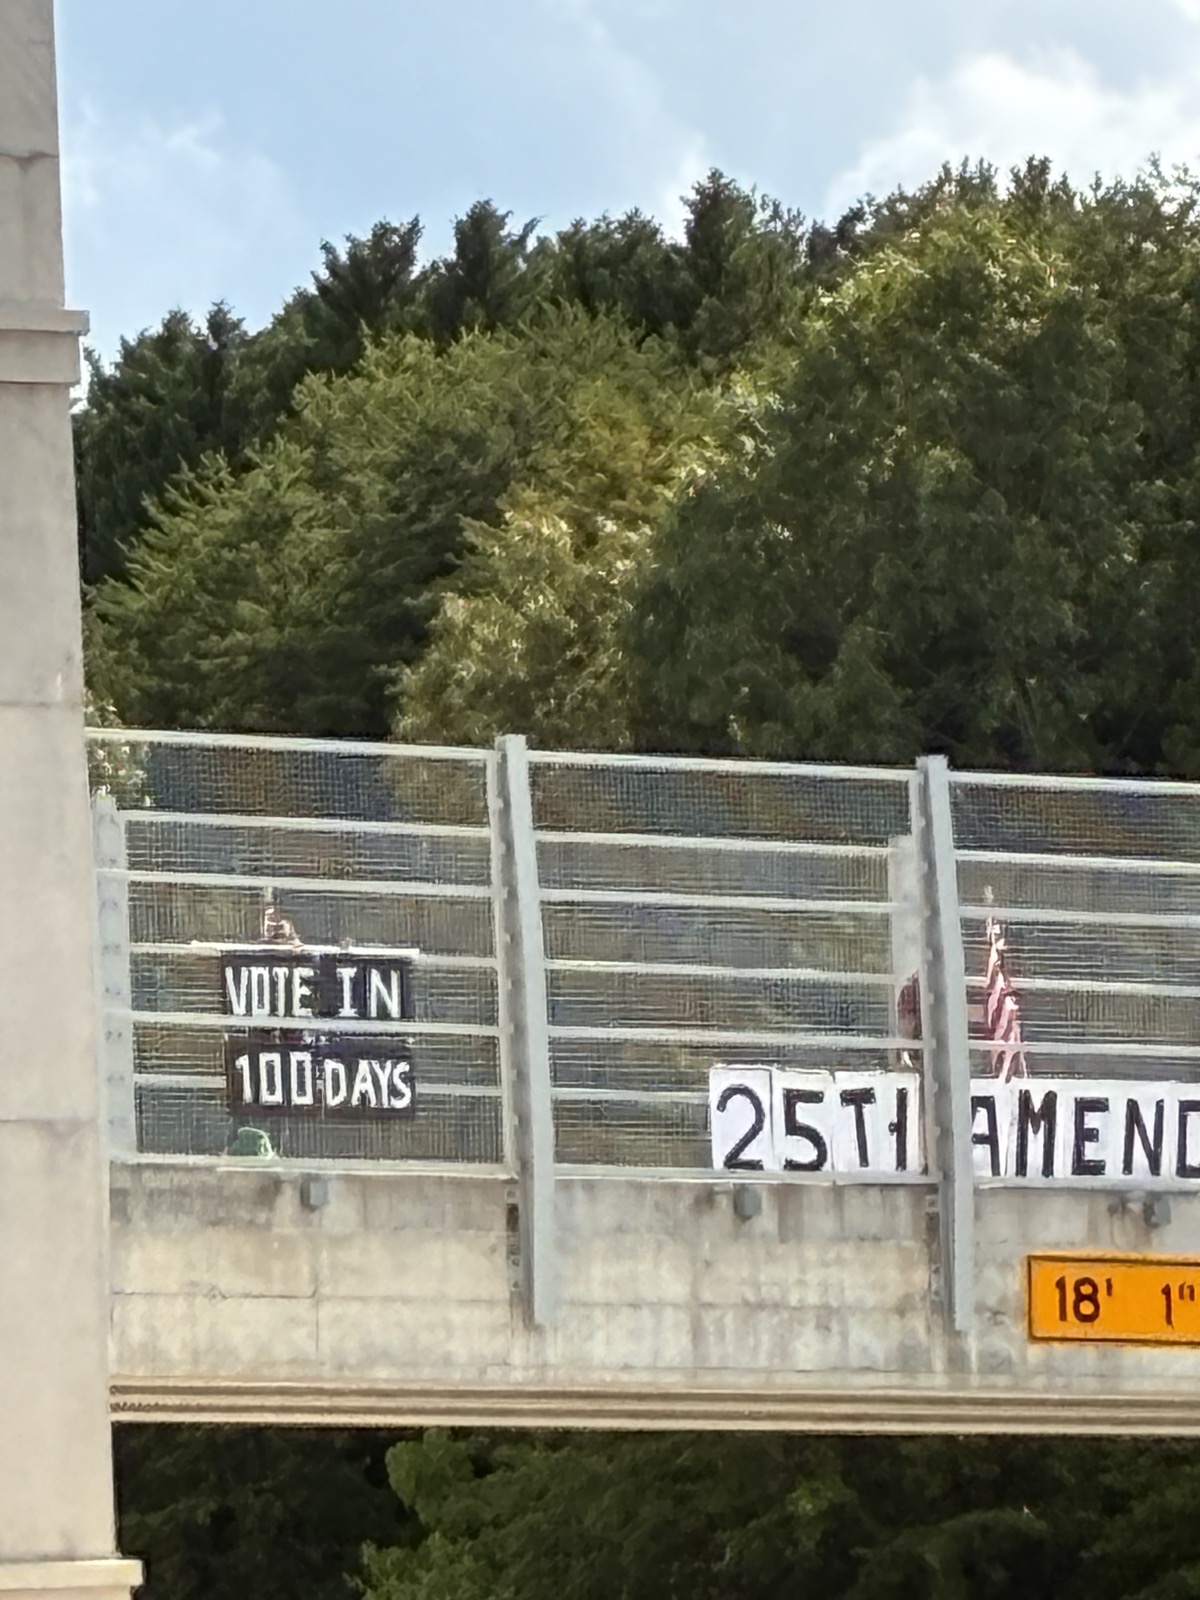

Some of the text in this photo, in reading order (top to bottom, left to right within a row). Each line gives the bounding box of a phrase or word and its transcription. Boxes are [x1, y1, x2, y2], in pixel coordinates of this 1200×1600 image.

[225, 966, 401, 1018] VOTE IN
[235, 1051, 412, 1109] 100 DAYS
[1055, 1276, 1113, 1323] 18'
